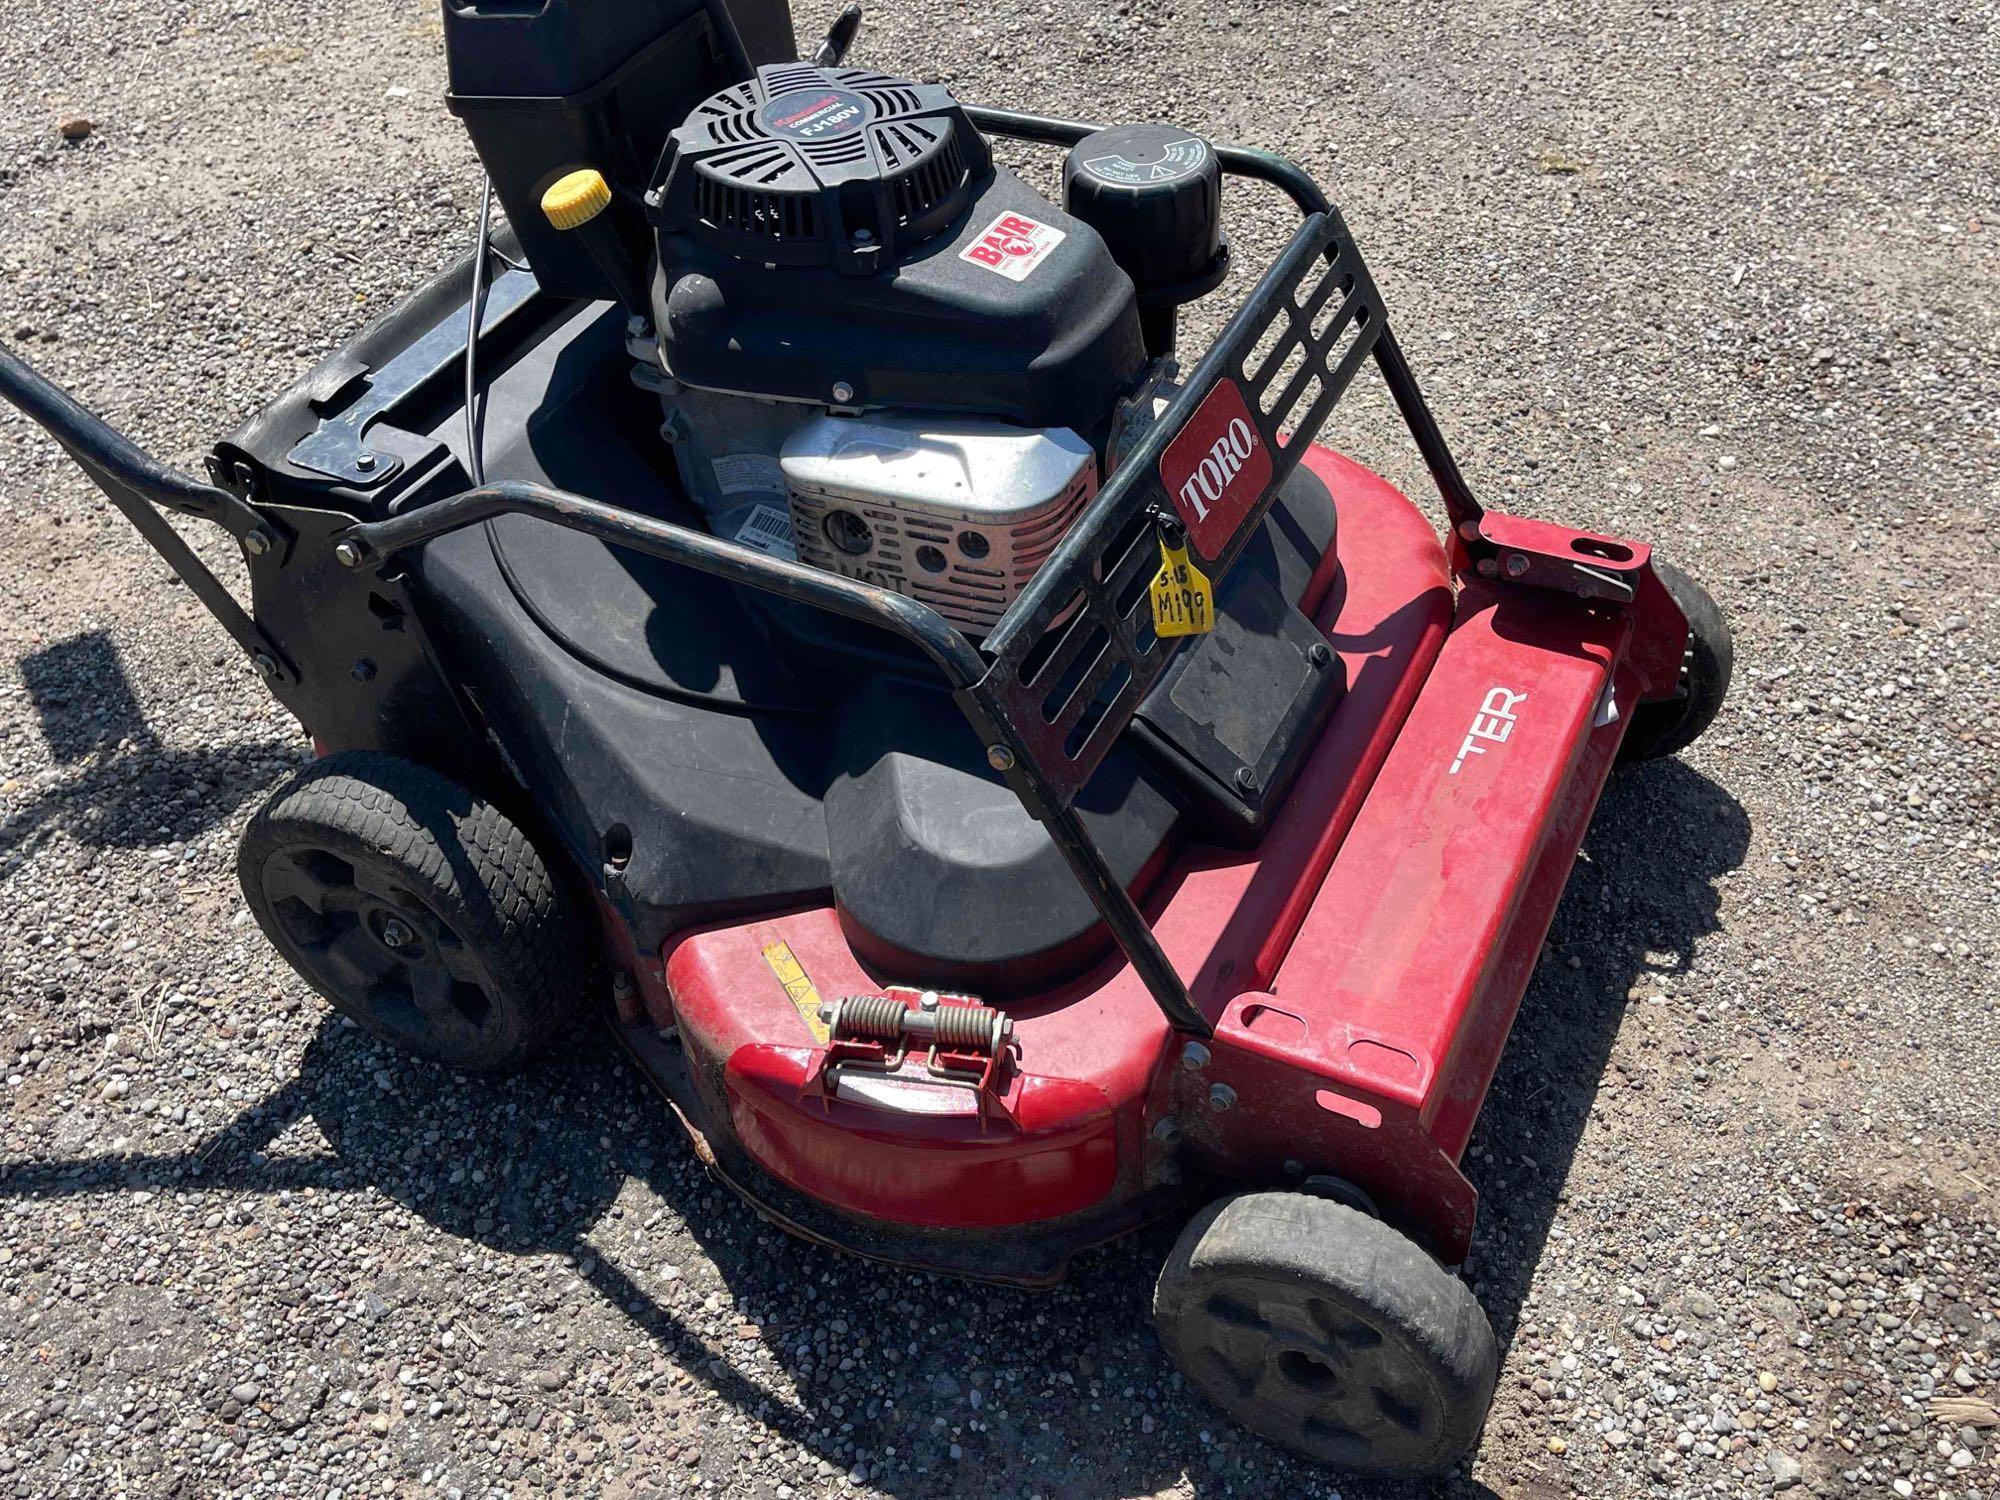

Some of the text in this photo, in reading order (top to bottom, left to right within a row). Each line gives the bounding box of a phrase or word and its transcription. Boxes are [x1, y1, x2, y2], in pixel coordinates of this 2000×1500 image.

[789, 102, 844, 129] COMMERCIAL
[799, 105, 860, 136] FJ180V
[968, 217, 1035, 267] BAIR
[1179, 418, 1253, 524] TORO
[1449, 686, 1528, 774] TER
